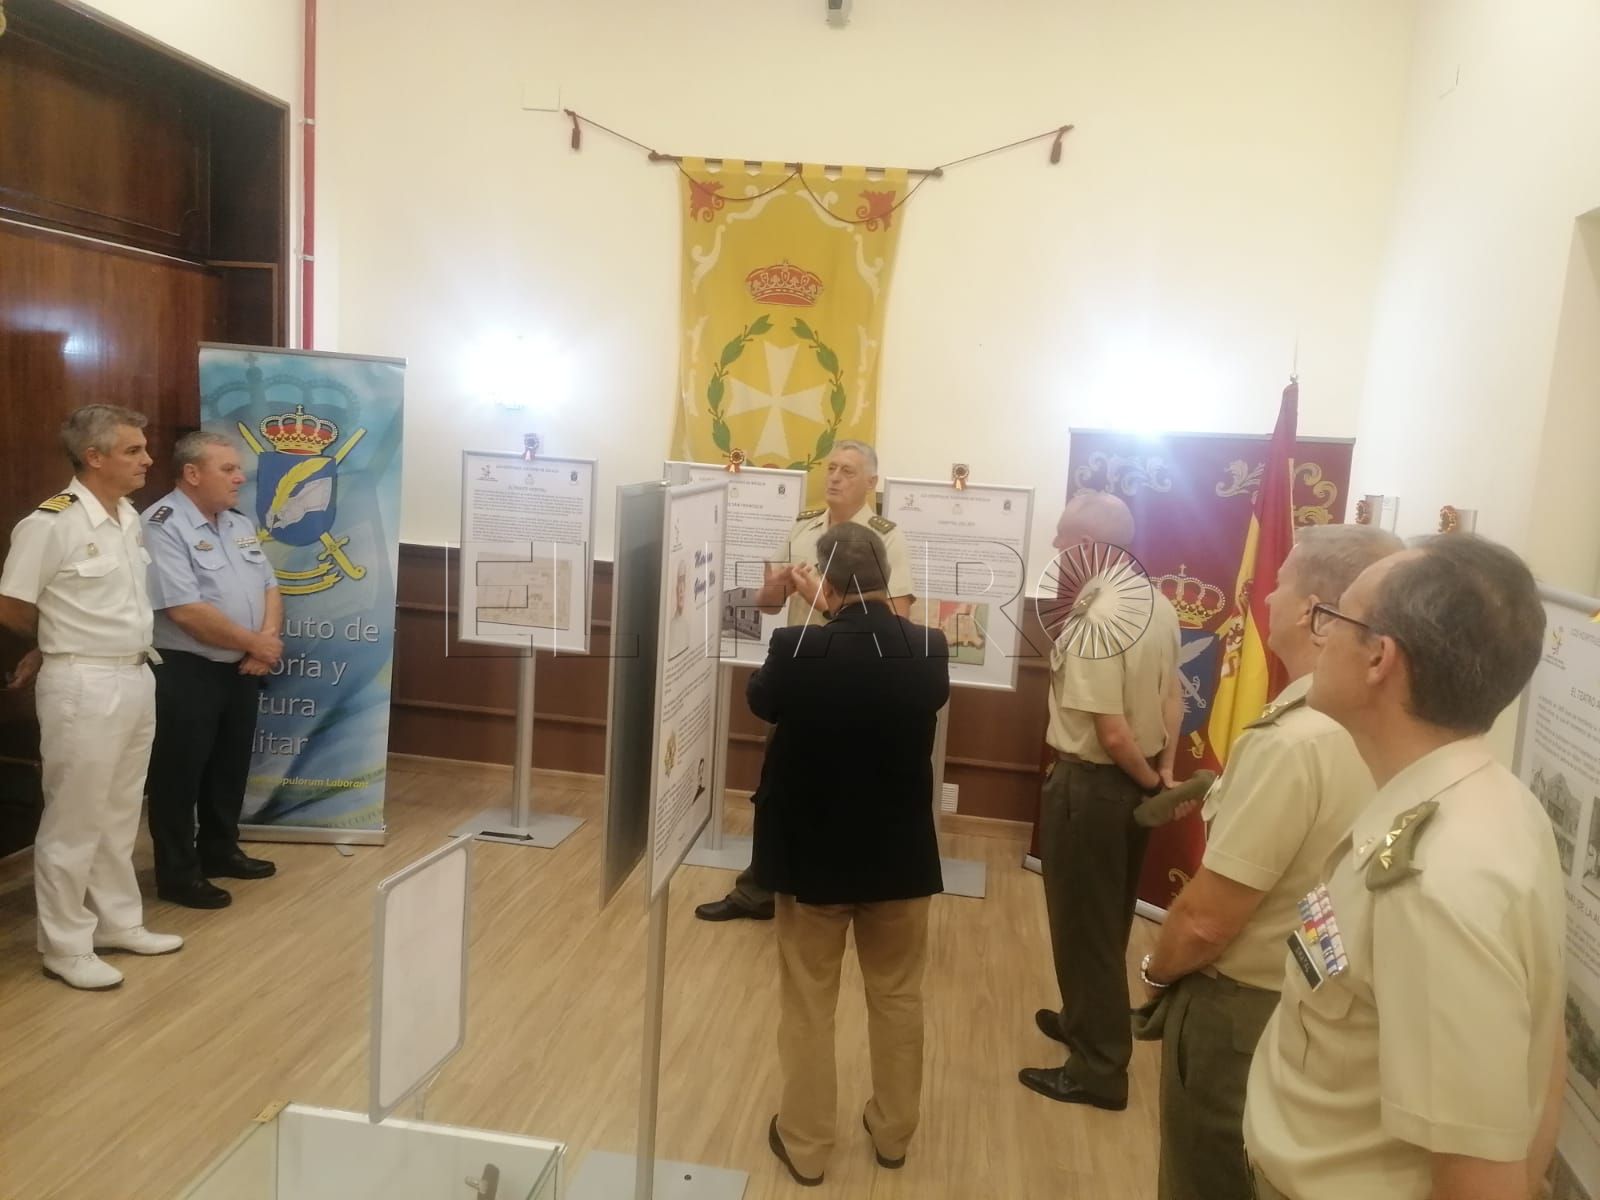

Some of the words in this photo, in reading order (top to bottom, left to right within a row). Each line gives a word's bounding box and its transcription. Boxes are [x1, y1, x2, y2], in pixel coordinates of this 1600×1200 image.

[281, 616, 335, 639] uto
[344, 616, 379, 642] de
[270, 653, 322, 678] oria
[332, 661, 348, 686] y
[258, 692, 316, 718] tura
[252, 727, 309, 756] litar
